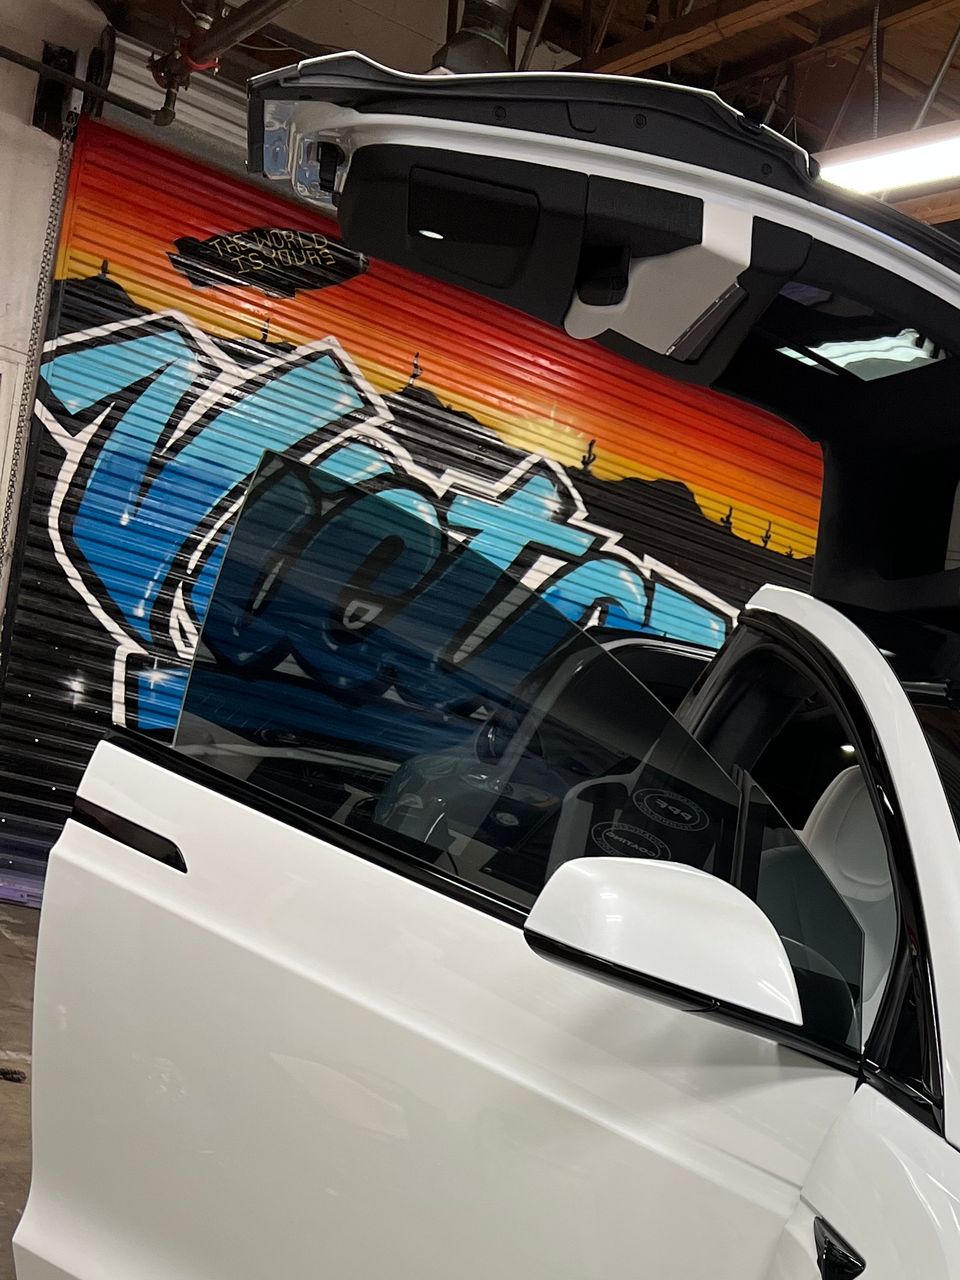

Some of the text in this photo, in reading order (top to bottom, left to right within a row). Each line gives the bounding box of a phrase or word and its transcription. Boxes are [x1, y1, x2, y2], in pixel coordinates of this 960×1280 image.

[210, 230, 328, 256] THE WORLD
[231, 249, 336, 274] IS YOURS
